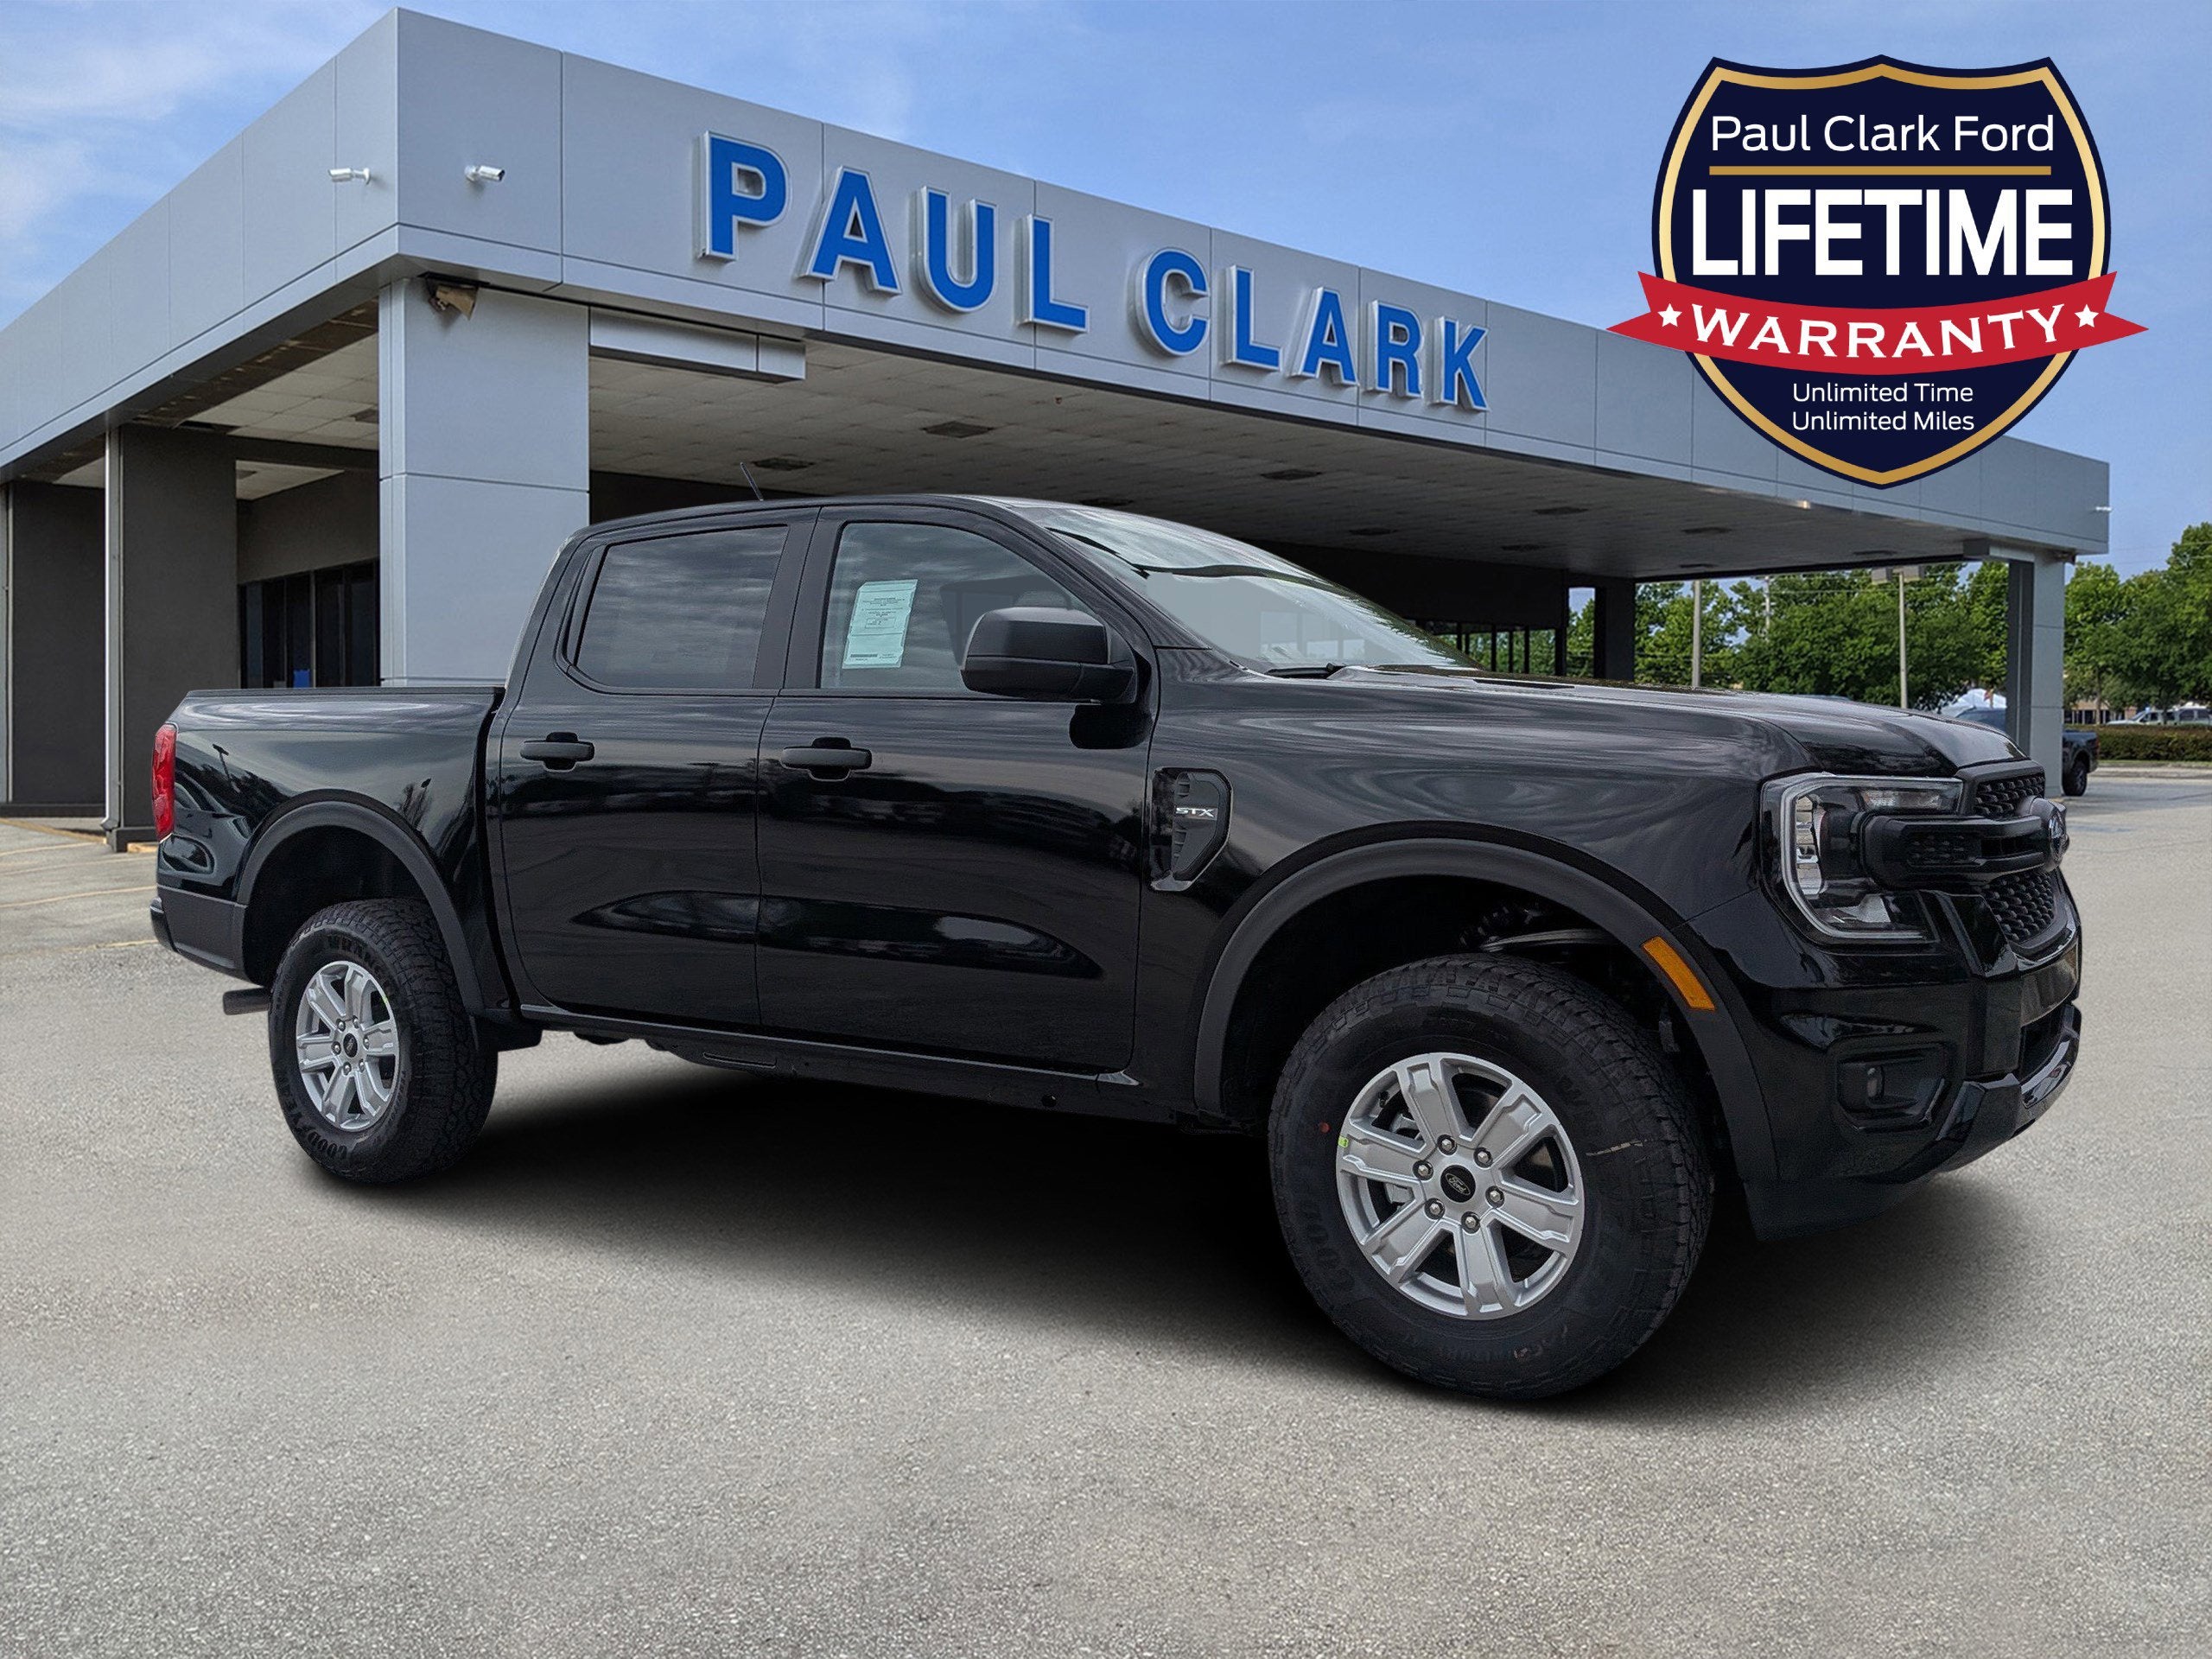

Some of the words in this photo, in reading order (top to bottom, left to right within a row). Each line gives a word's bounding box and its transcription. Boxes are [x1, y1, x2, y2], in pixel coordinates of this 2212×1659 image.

[702, 131, 1089, 333] PAUL
[1141, 249, 1489, 410] CLARK
[1175, 807, 1215, 817] STX
